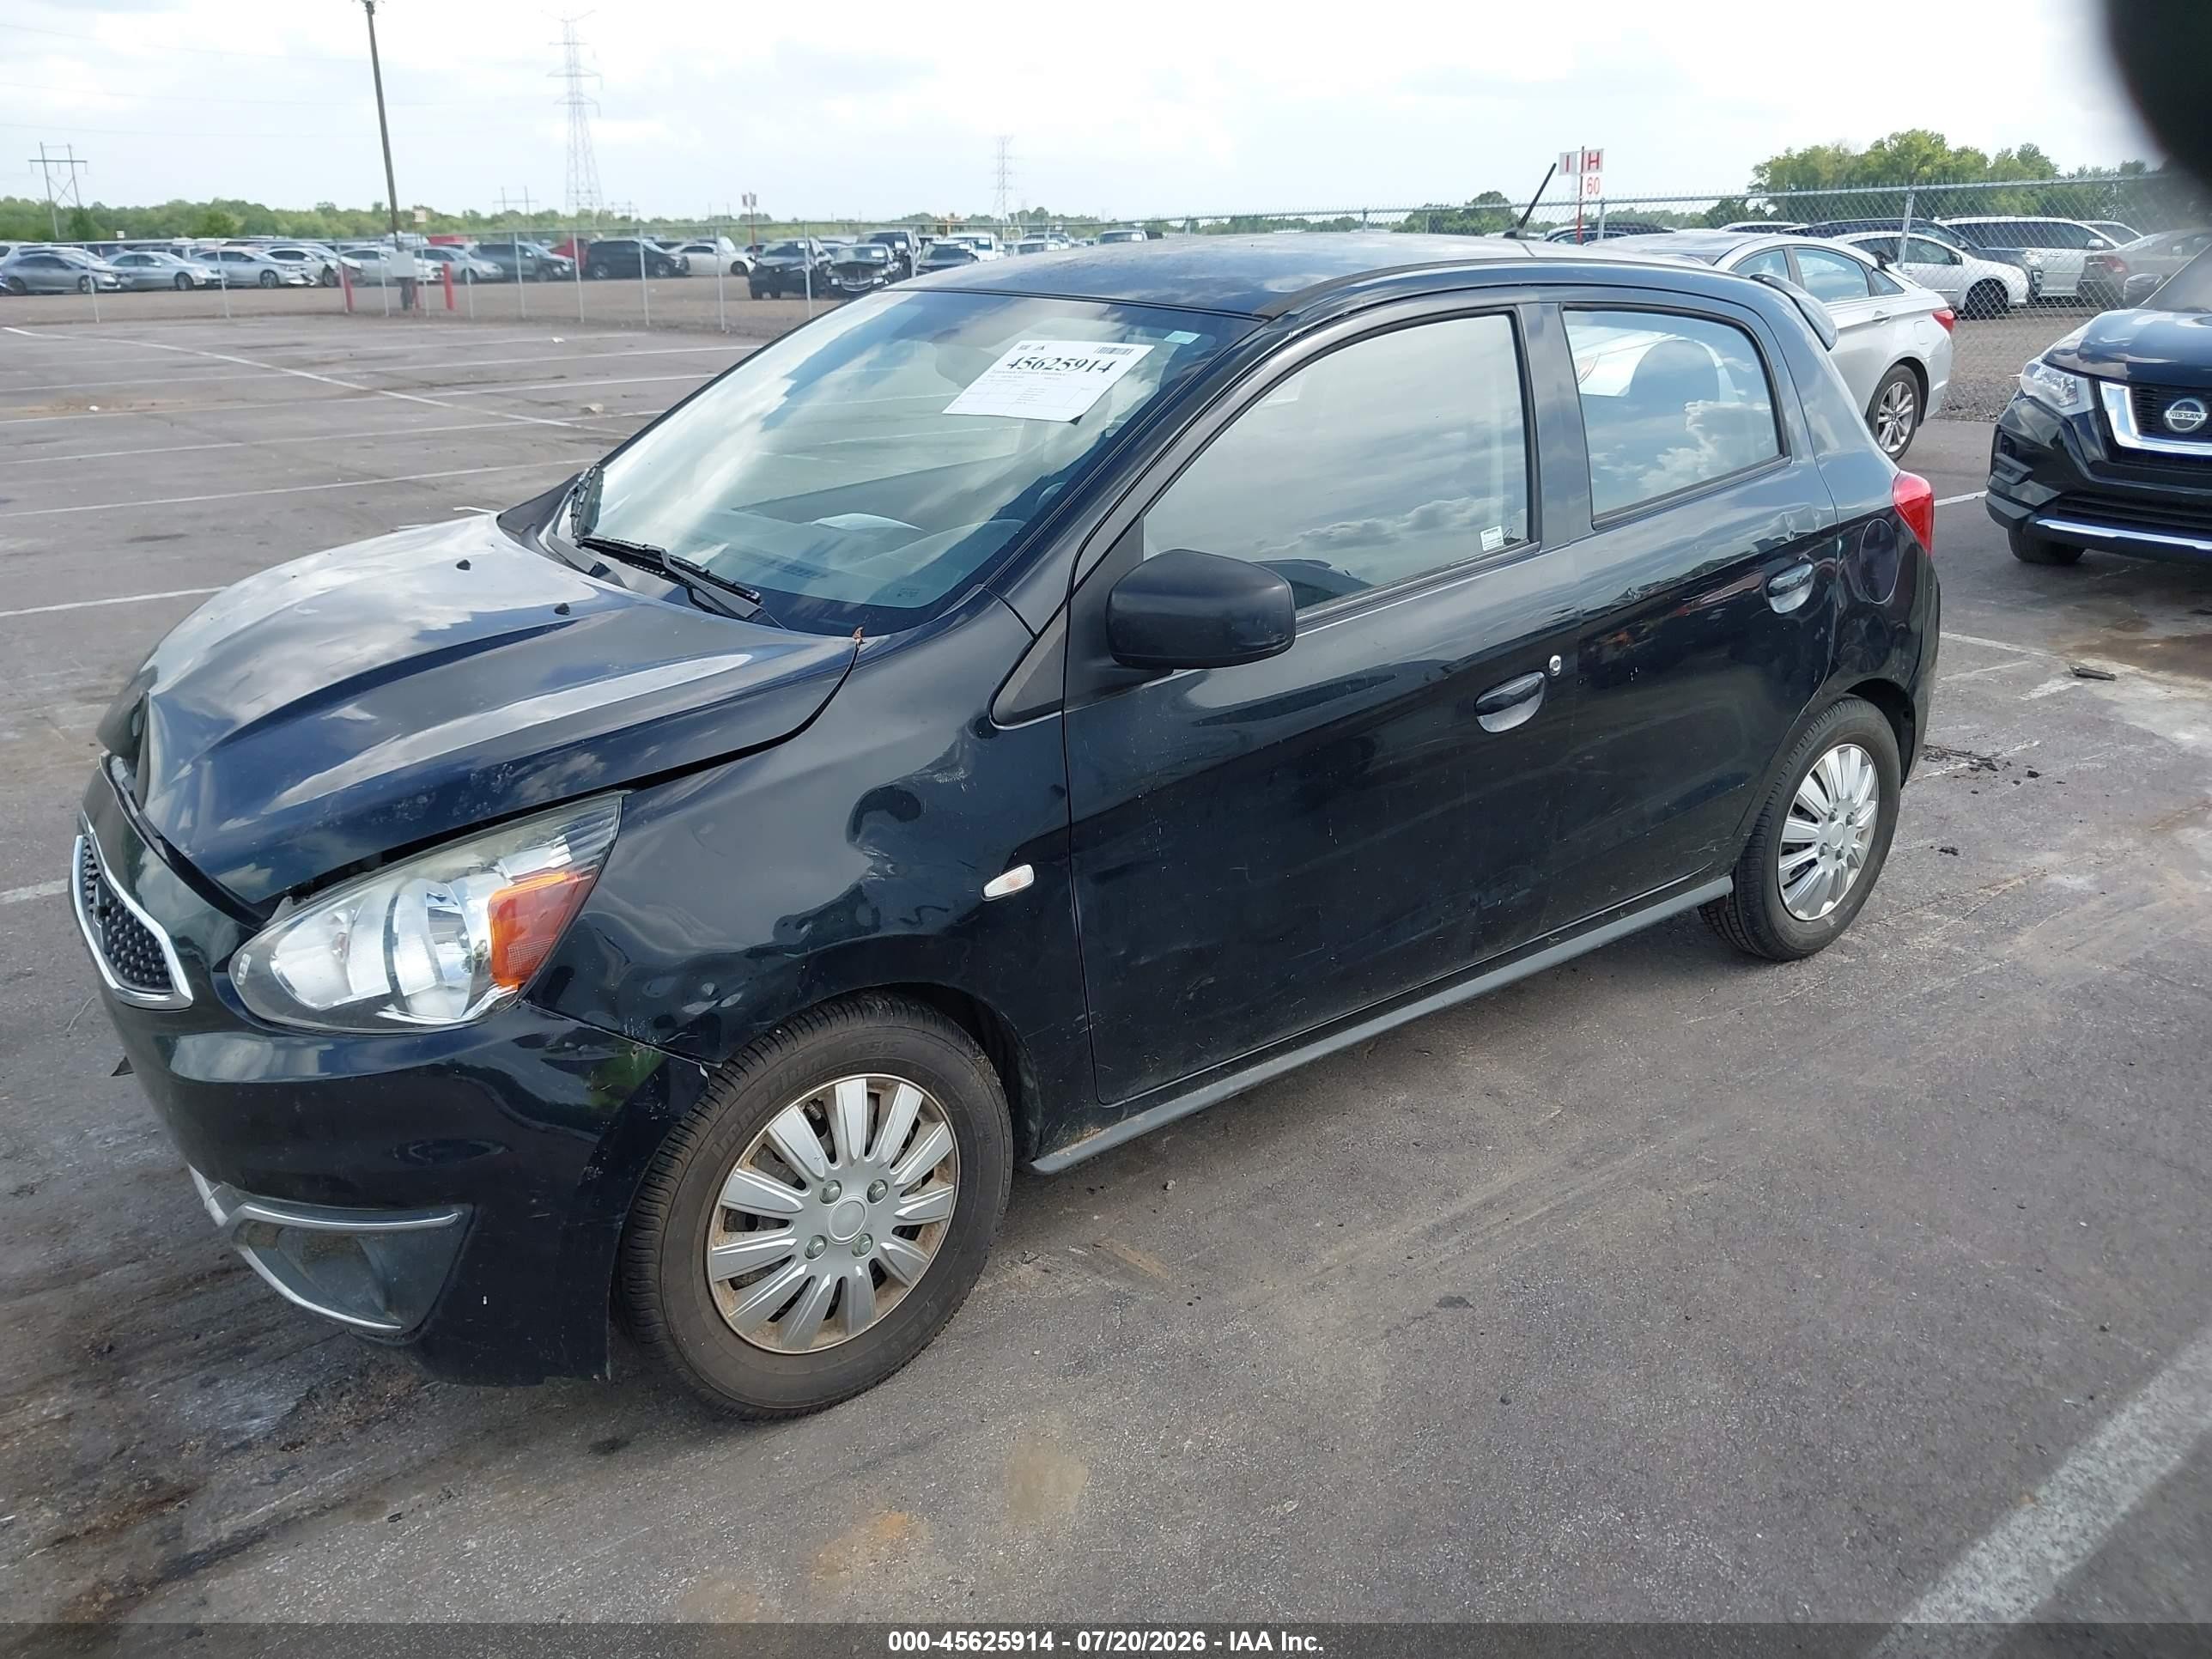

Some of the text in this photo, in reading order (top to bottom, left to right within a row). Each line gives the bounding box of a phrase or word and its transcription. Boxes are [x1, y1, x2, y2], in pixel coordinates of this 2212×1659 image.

[1587, 151, 1601, 171] H
[1586, 176, 1601, 195] 60
[1006, 356, 1117, 374] 45625914
